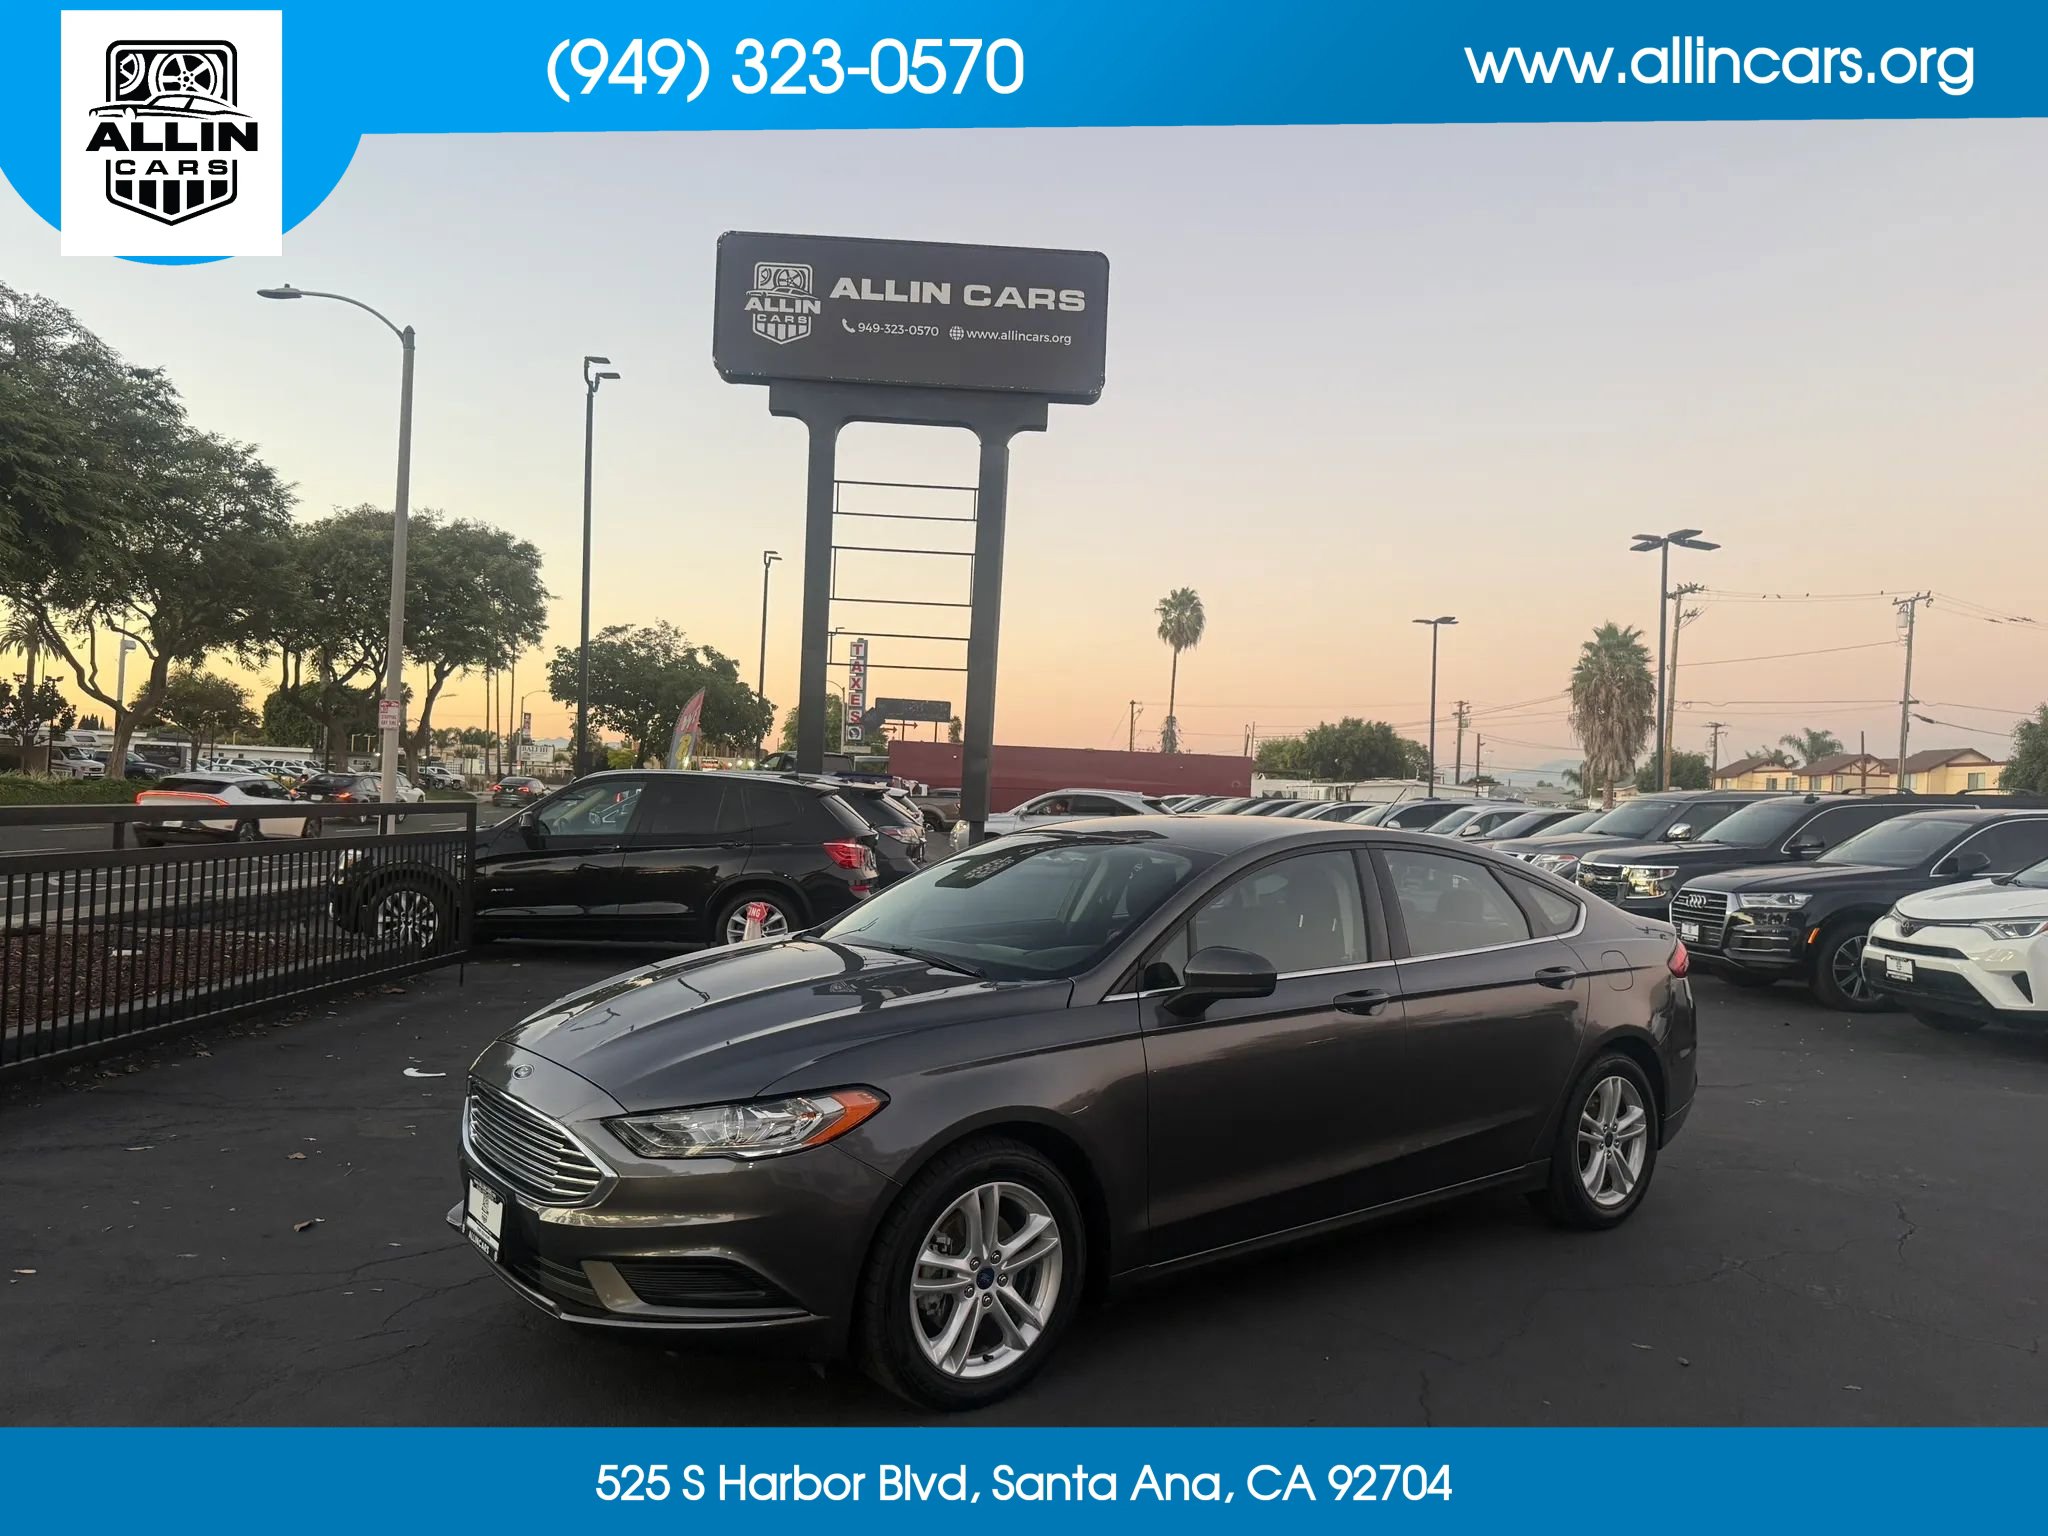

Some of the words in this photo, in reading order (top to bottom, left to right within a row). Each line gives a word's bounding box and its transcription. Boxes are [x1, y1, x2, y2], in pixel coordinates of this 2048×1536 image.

[830, 277, 951, 305] ALLIN
[963, 284, 1086, 312] CARS
[744, 296, 821, 315] ALLIN
[757, 314, 807, 324] CARS
[857, 321, 939, 337] 949-323-0570
[966, 328, 1072, 346] www.allincars.org
[850, 644, 863, 724] TAXES
